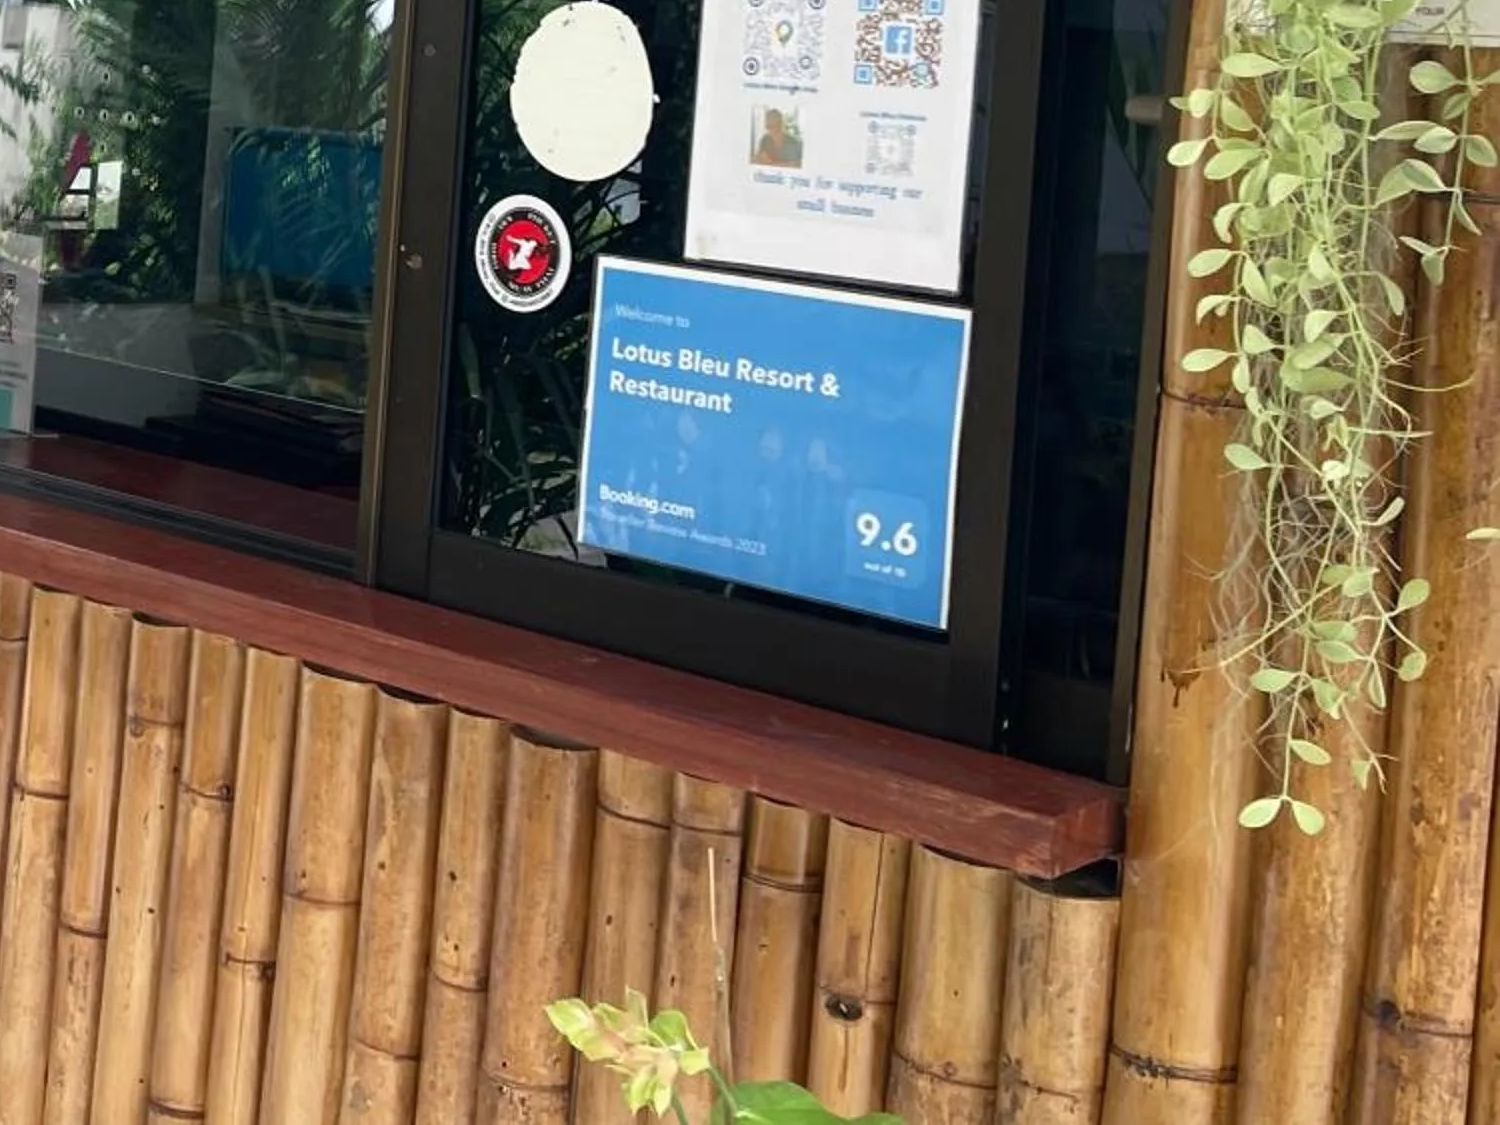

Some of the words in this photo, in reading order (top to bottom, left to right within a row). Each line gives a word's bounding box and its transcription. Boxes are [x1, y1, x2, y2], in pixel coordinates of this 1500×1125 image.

[789, 175, 810, 190] you
[838, 180, 897, 201] supporting
[615, 303, 673, 328] Welcome
[675, 314, 691, 329] to
[611, 336, 674, 370] Lotus
[677, 347, 731, 379] Bleu
[735, 358, 814, 394] Resort
[819, 372, 841, 398] &
[609, 370, 733, 414] Restaurant
[599, 484, 696, 521] Booking.com
[855, 512, 919, 557] 9.6
